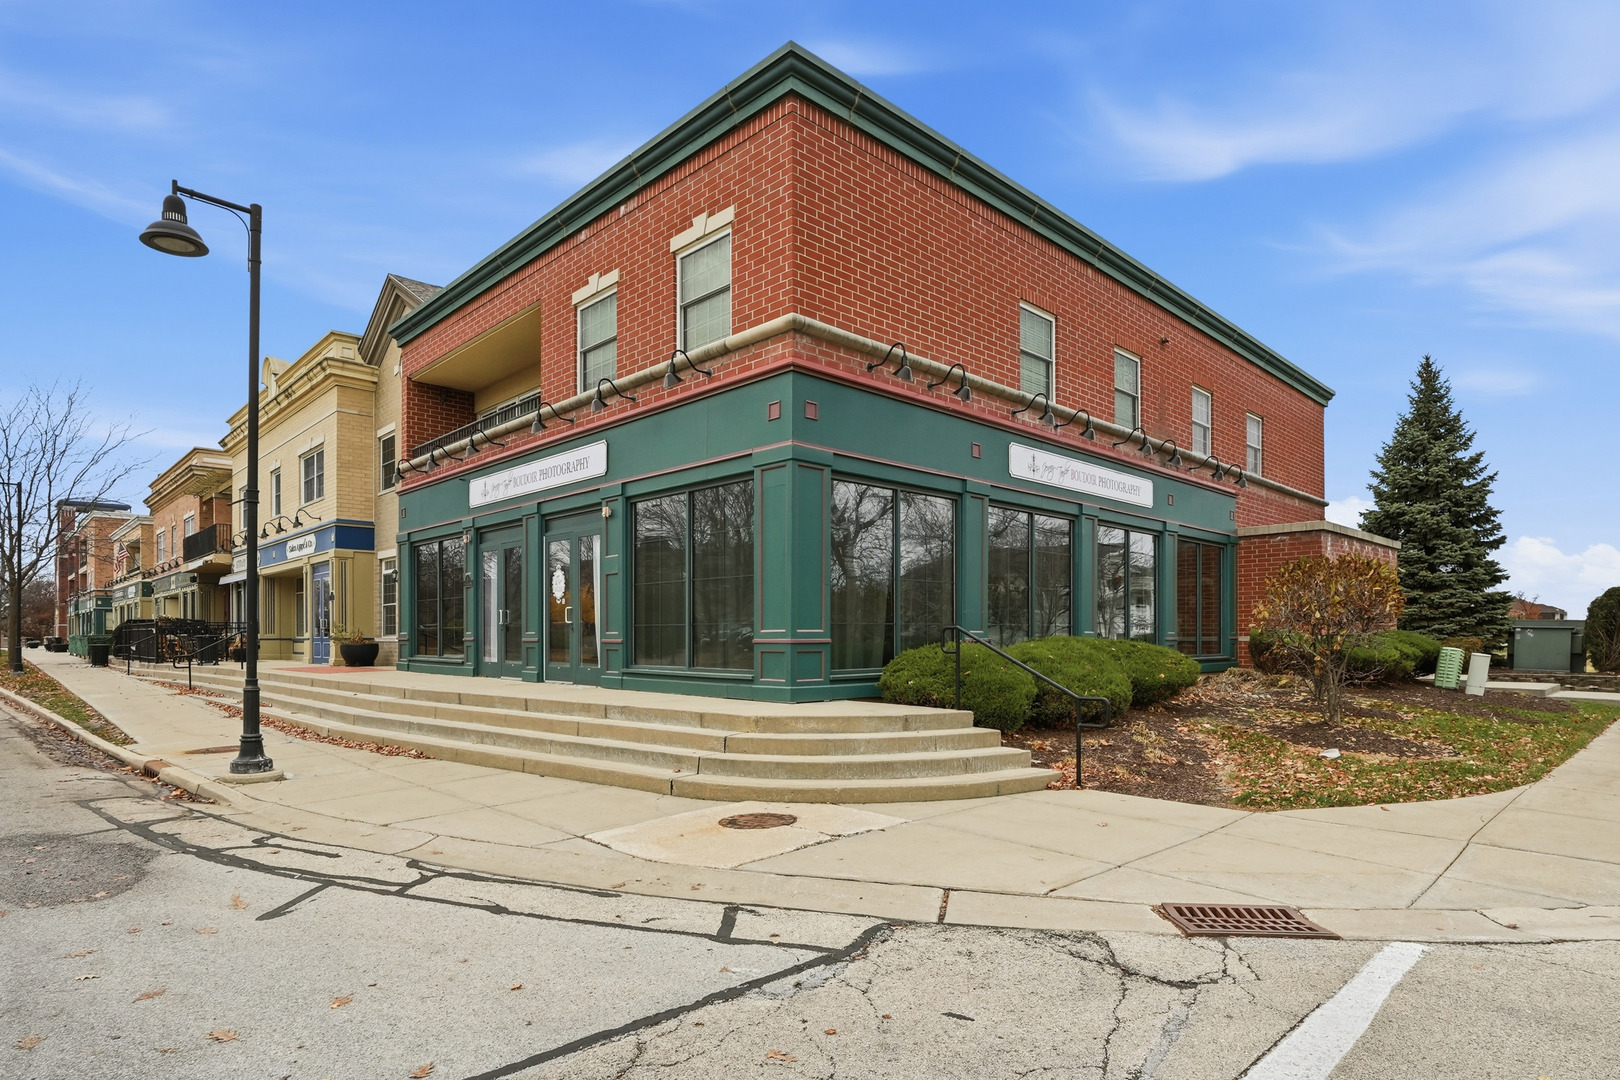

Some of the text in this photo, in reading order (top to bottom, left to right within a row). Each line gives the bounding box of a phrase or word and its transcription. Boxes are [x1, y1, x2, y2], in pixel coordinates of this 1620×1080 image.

[513, 471, 538, 488] BOUDOIR
[538, 456, 590, 481] PHOTOGRAPHY
[1070, 468, 1097, 485] BOUDOIR
[1098, 476, 1142, 497] PHOTOGRAPHY
